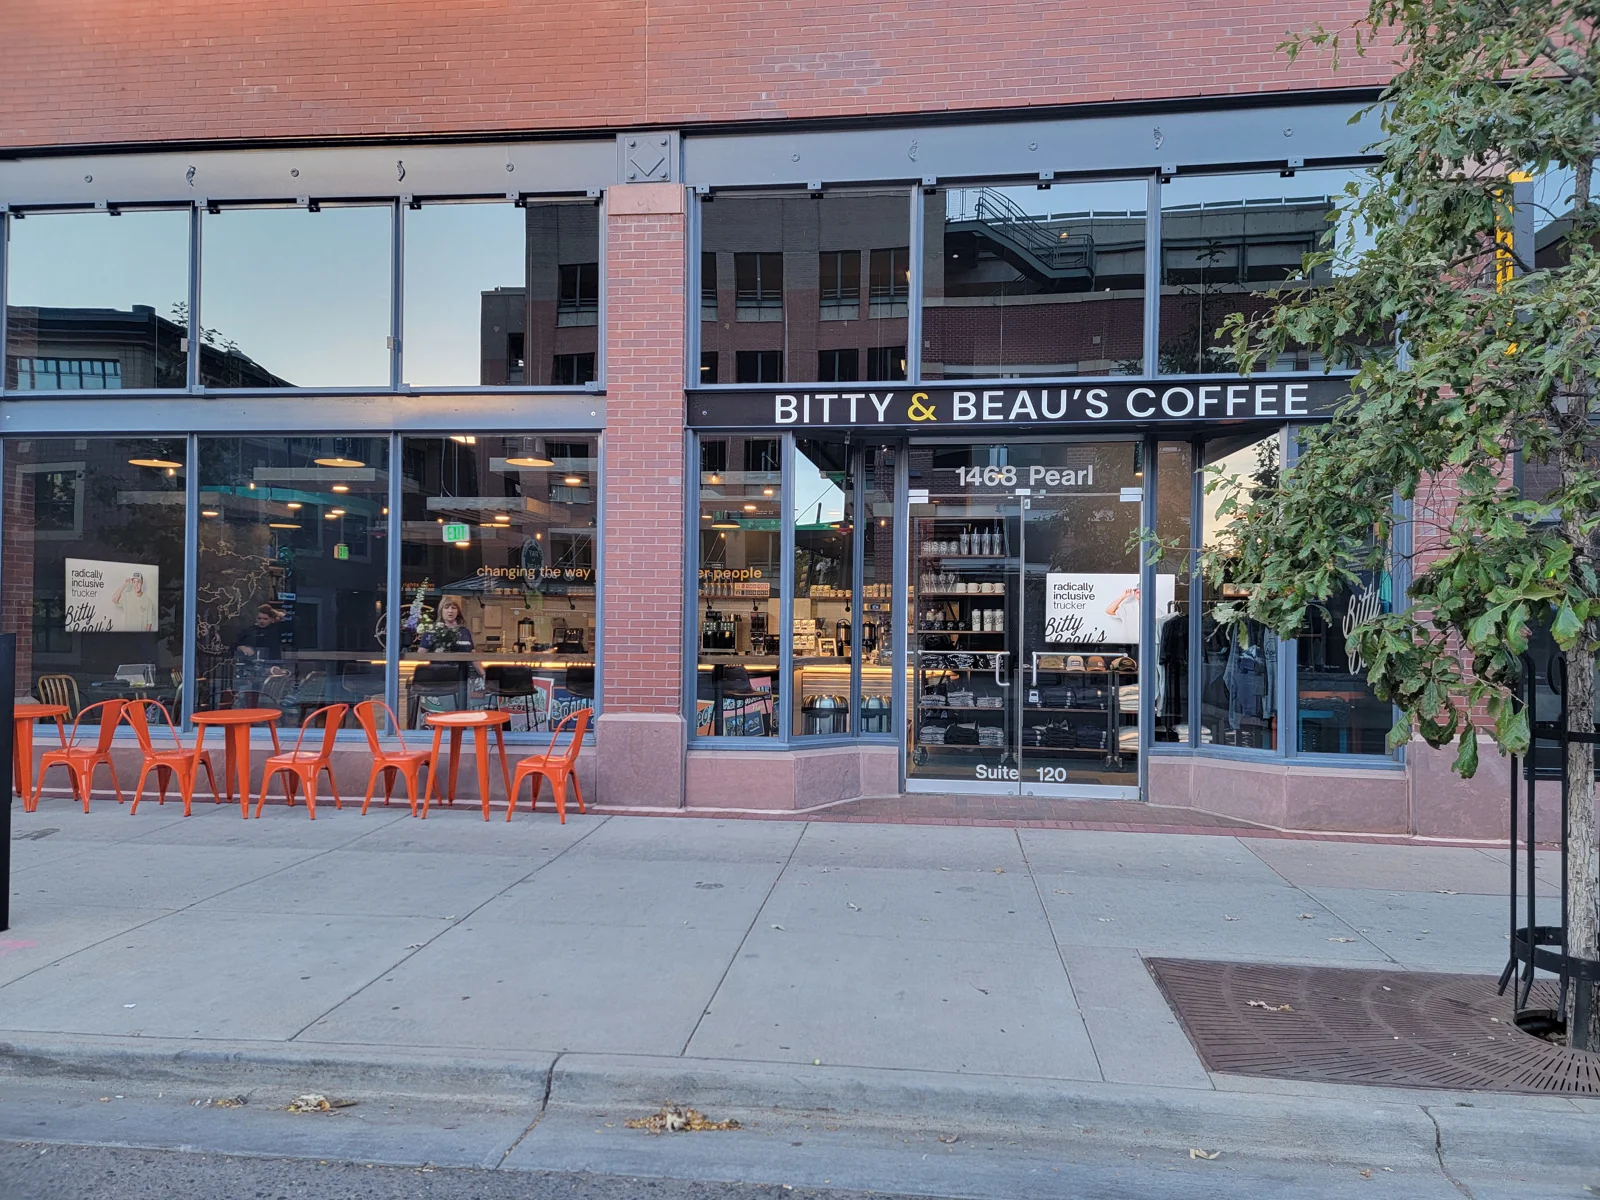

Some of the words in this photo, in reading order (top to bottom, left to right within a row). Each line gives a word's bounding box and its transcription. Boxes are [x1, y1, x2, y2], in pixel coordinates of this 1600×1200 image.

[774, 392, 895, 424] BITTY
[906, 392, 938, 422] &
[952, 388, 1109, 421] BEAU'S
[1126, 384, 1309, 417] COFFEE
[955, 465, 1017, 487] 1468
[1029, 464, 1093, 487] Pearl
[447, 525, 465, 540] EXIT
[71, 568, 104, 581] radically
[476, 564, 536, 580] changing
[540, 565, 561, 577] the
[565, 568, 591, 580] way
[713, 567, 762, 581] people
[71, 577, 104, 588] inclusive
[1053, 582, 1094, 593] radically
[71, 588, 98, 598] trucker
[1053, 591, 1096, 601] inclusive
[1053, 601, 1086, 610] trucker
[65, 602, 96, 626] Bitty
[1045, 614, 1084, 637] Bitty
[975, 764, 1019, 780] Suite
[1036, 766, 1067, 782] 120
